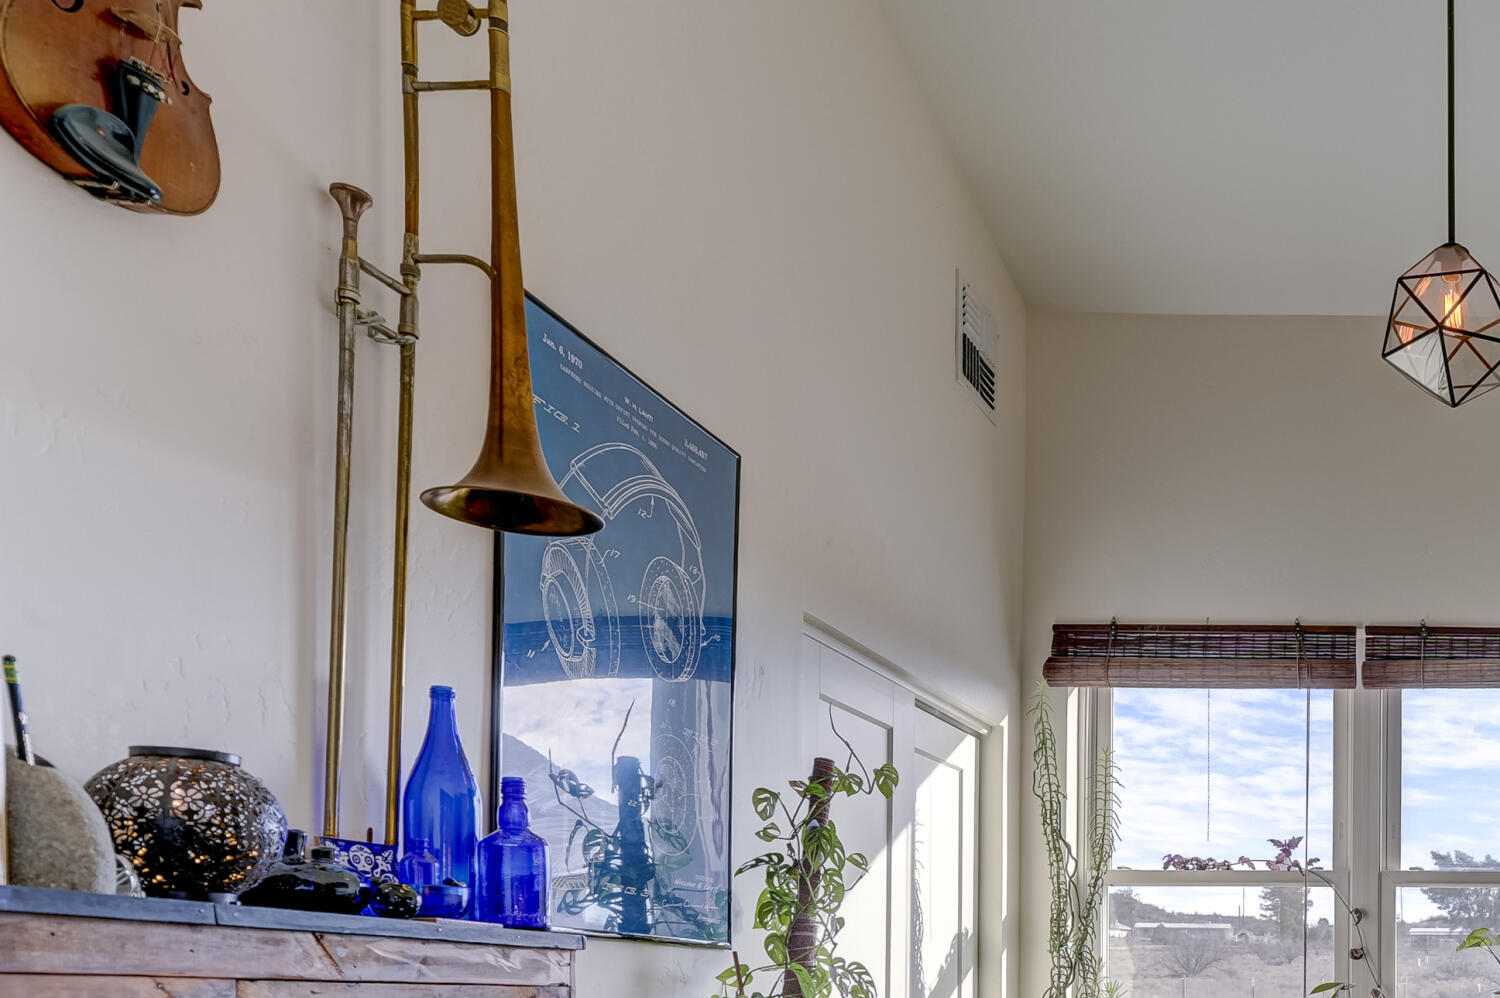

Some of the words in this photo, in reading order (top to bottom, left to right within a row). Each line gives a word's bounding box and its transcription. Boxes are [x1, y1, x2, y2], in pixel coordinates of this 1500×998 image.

[543, 333, 557, 350] Jan.
[558, 345, 566, 358] 6,
[567, 351, 583, 369] 1970
